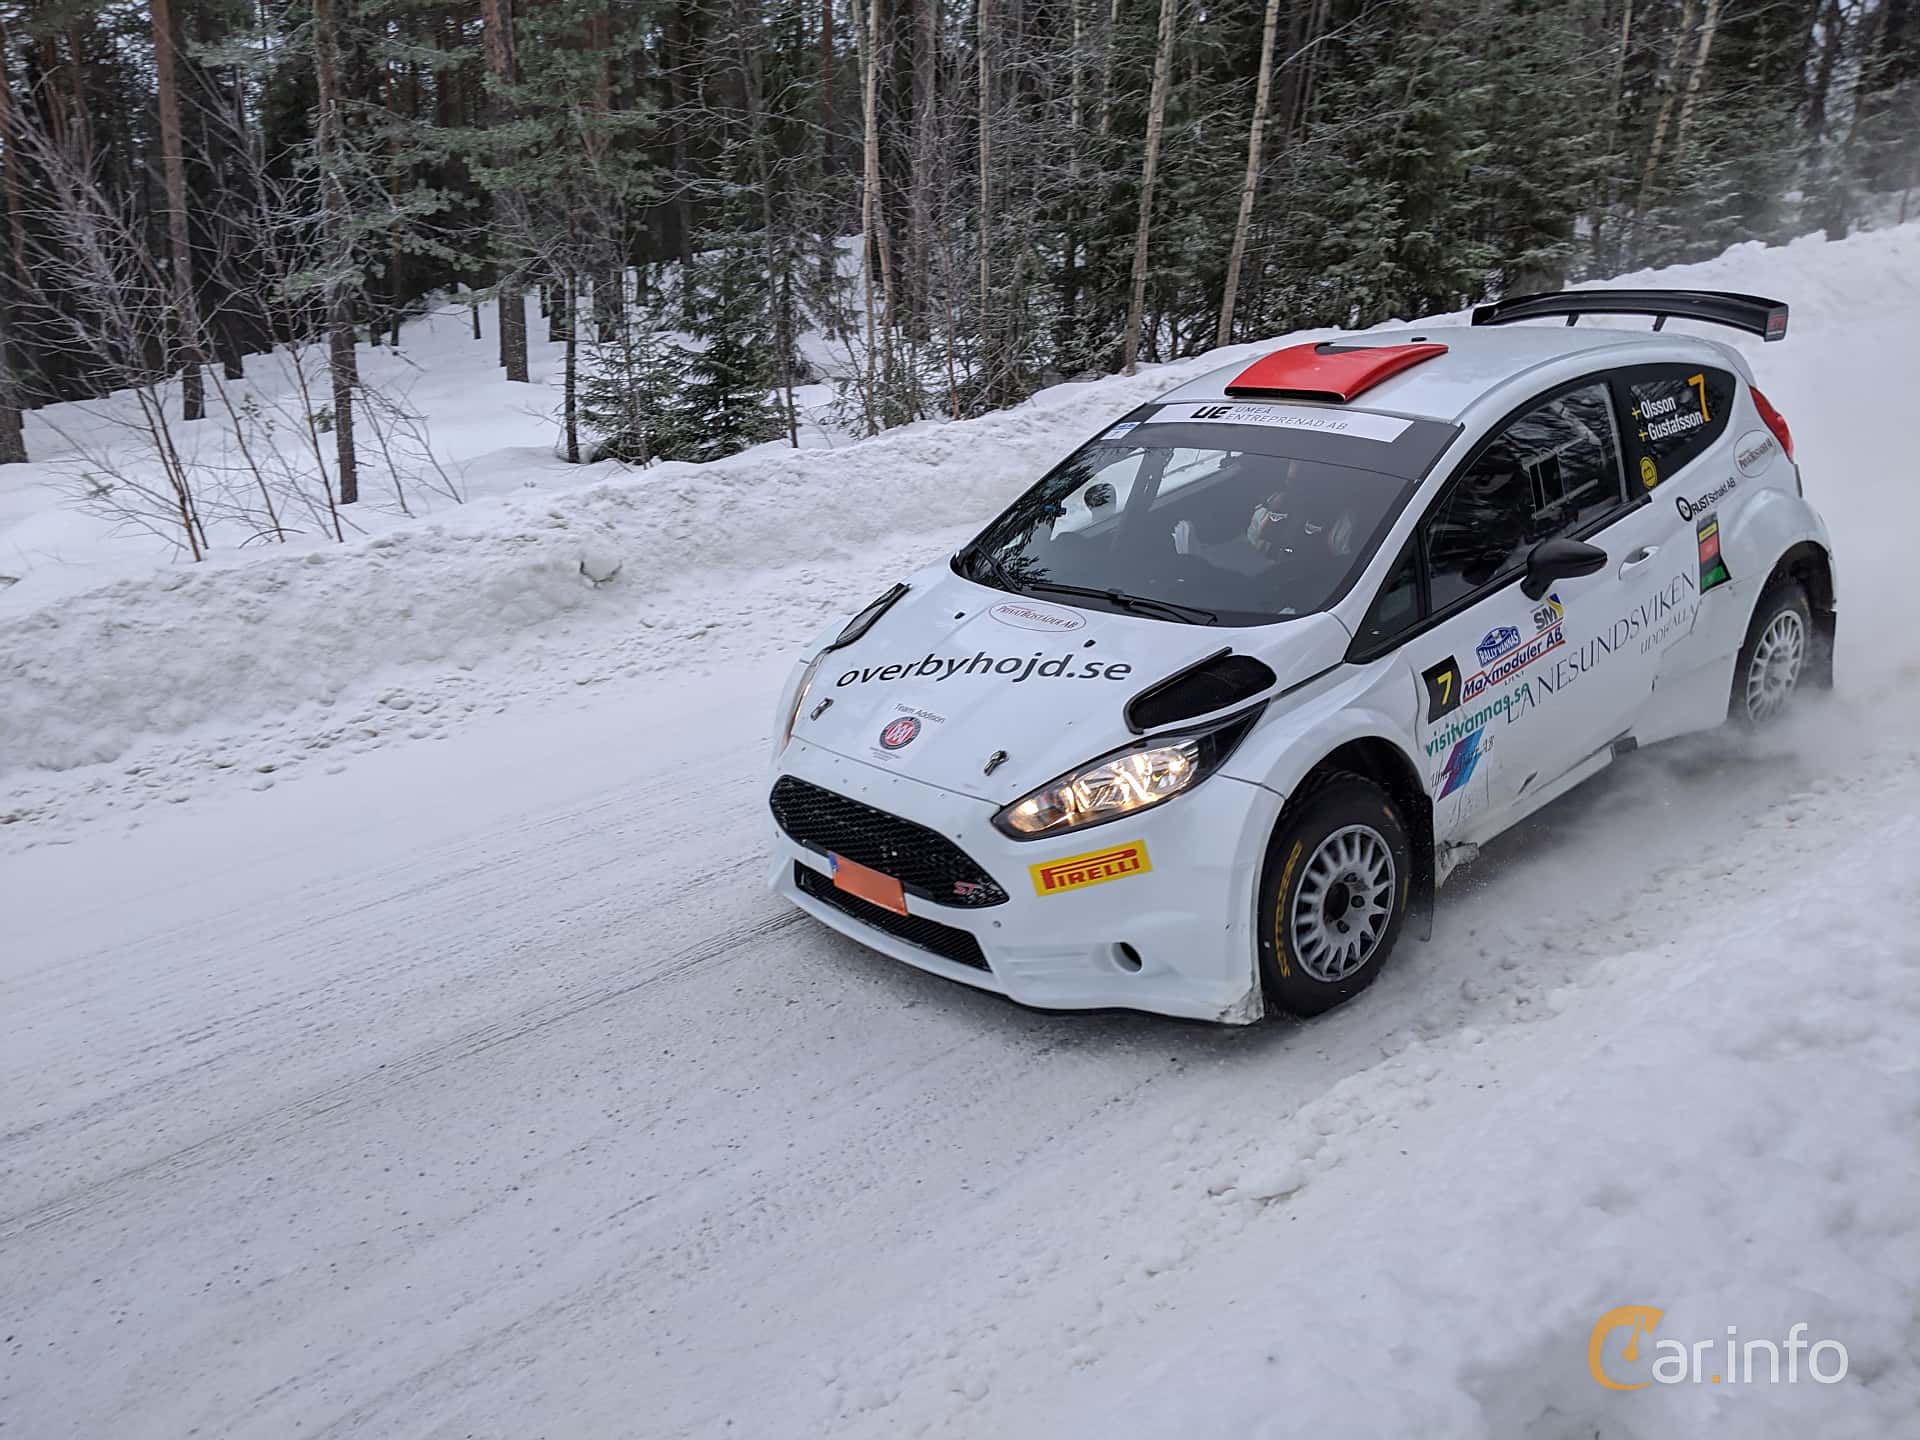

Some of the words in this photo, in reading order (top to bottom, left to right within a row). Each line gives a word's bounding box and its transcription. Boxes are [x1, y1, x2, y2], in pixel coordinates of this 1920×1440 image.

[1640, 396, 1676, 419] Olsson
[1687, 373, 1711, 423] 7
[1226, 413, 1325, 428] ENTREPRENAD
[1327, 422, 1347, 431] AB
[1647, 411, 1703, 441] Gustafsson
[1691, 494, 1710, 515] RUST
[1534, 606, 1558, 630] SM
[836, 651, 1132, 687] overbyhojd.se
[1462, 642, 1543, 700] Maxmoduler
[1546, 627, 1563, 648] AB
[1437, 670, 1453, 705] 7
[1040, 849, 1140, 890] PIRELLI
